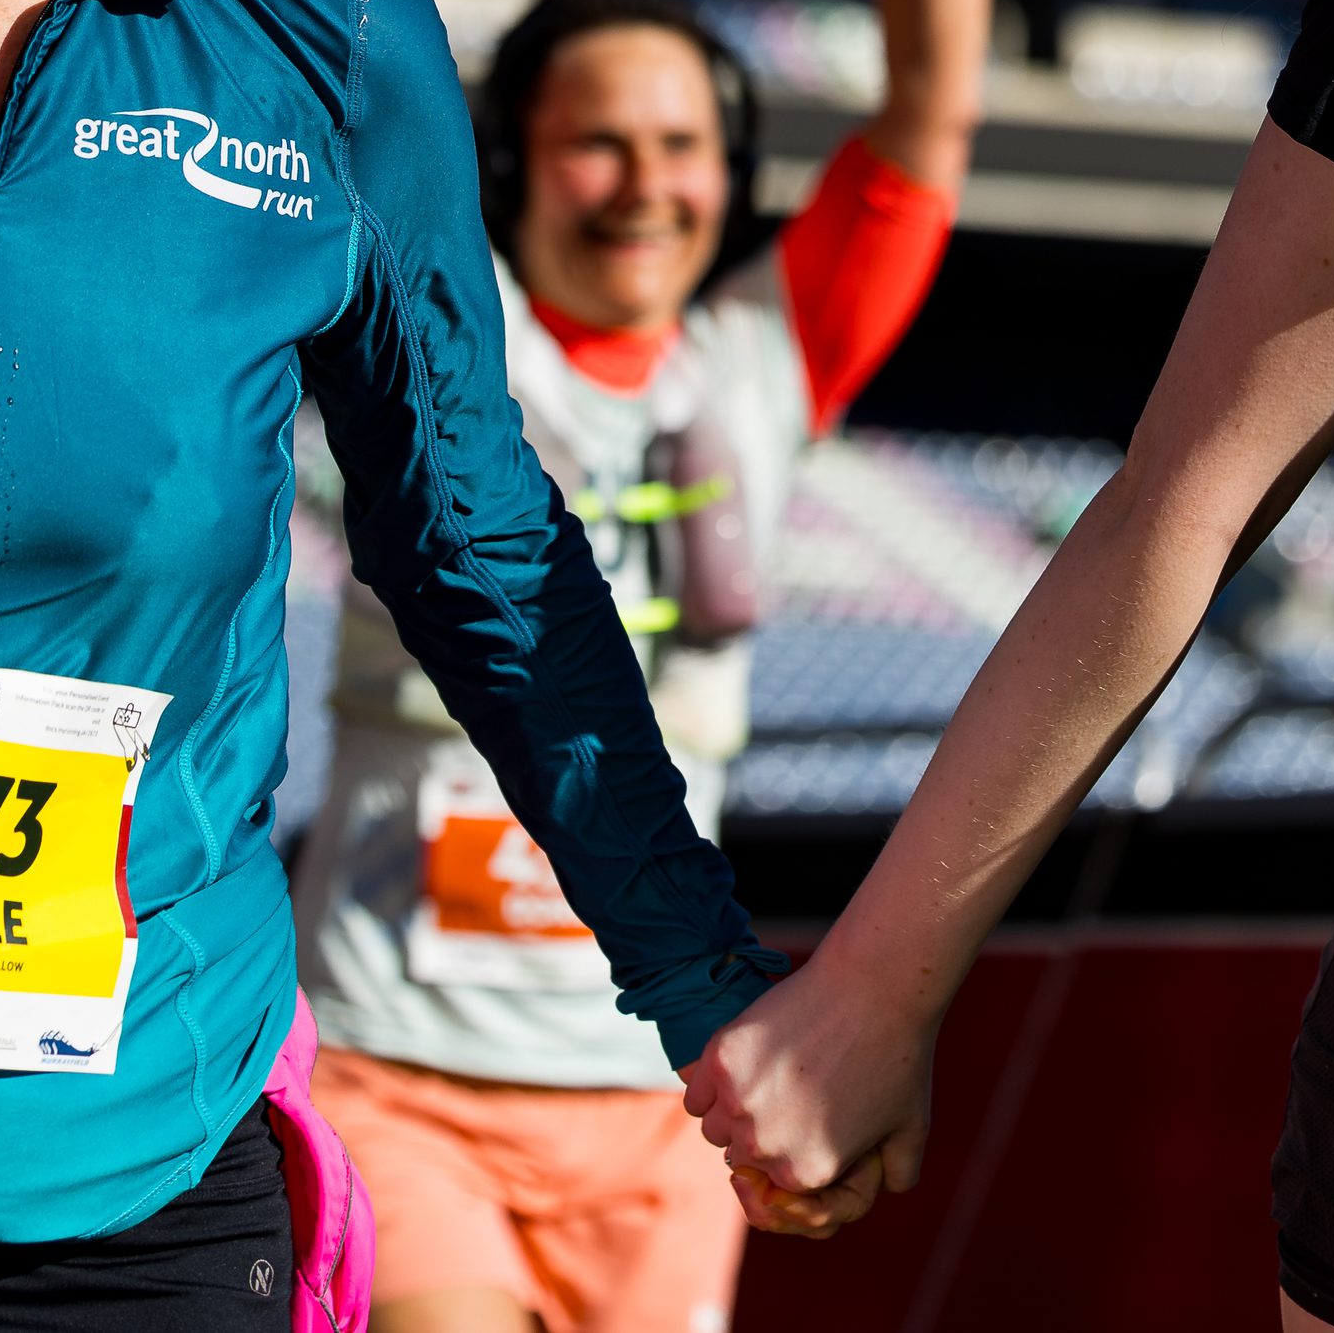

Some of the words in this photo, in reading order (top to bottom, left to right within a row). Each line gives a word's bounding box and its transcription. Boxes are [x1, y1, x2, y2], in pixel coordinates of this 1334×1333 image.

[73, 118, 180, 159] great
[220, 136, 310, 183] north
[262, 189, 313, 220] run
